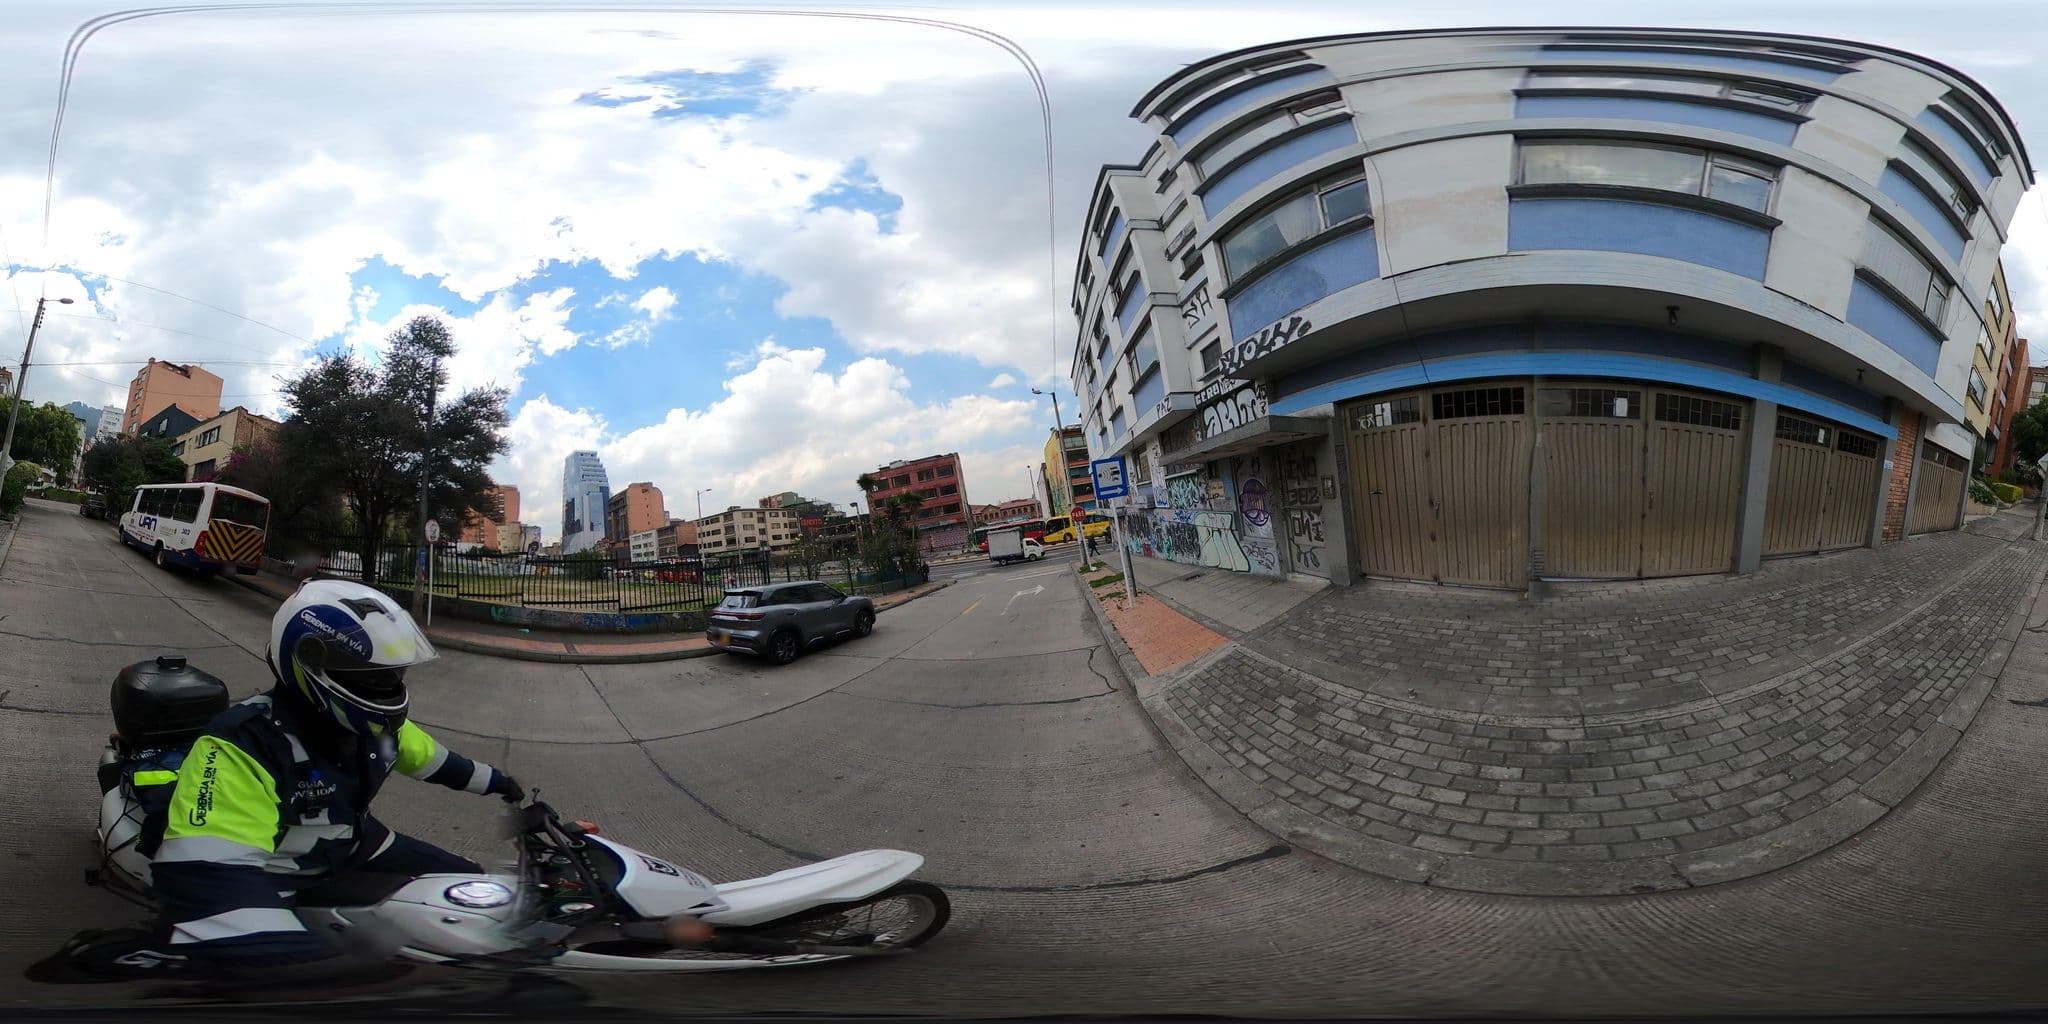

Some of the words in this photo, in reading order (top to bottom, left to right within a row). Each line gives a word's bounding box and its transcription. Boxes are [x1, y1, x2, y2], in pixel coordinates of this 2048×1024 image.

[1155, 396, 1172, 419] PAZ
[1071, 510, 1085, 518] PARE
[300, 609, 336, 636] GERENCIA
[189, 780, 210, 827] GERENCIA
[203, 766, 214, 779] EN
